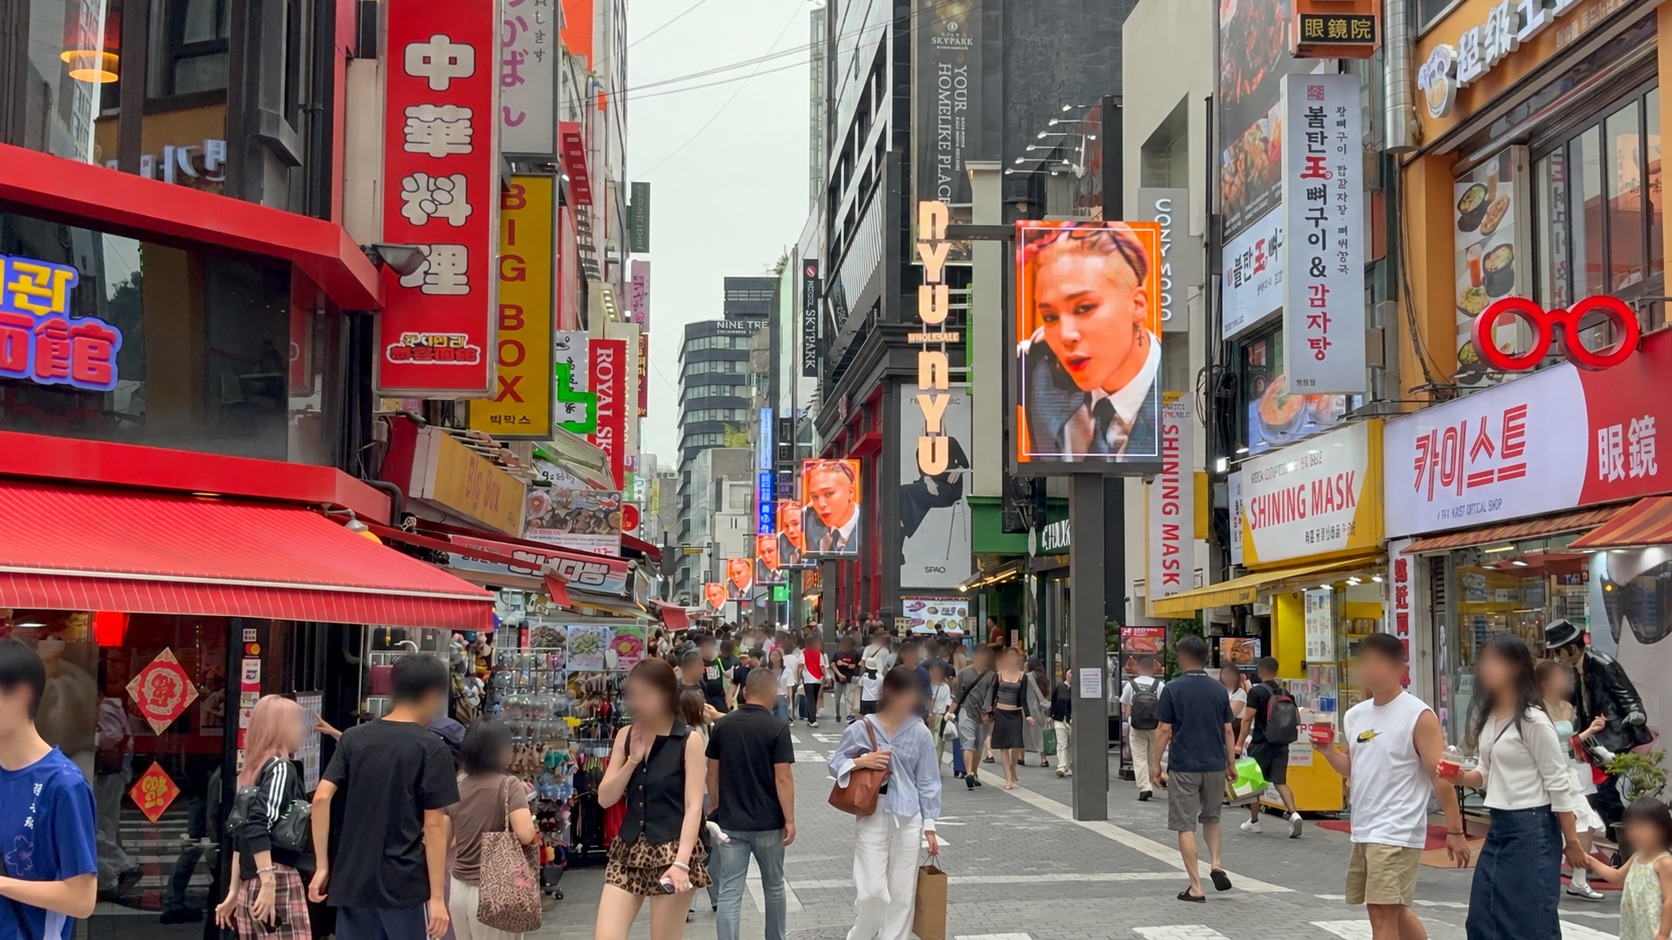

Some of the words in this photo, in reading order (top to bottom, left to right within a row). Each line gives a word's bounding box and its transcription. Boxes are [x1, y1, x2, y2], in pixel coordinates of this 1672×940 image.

[931, 36, 974, 46] SKYPARK
[1305, 18, 1371, 39] 眼鏡院
[937, 62, 952, 150] HOMELIKE
[954, 64, 968, 112] YOUR
[400, 34, 476, 295] 中華料理
[499, 184, 527, 283] BIG
[1307, 257, 1325, 278] &
[494, 304, 528, 402] BOX
[717, 321, 743, 329] NINE
[805, 309, 816, 368] SKYPARK
[1304, 284, 1330, 361] 감자탕
[597, 347, 614, 424] ROYAL
[1162, 424, 1179, 516] SHINING
[1413, 404, 1528, 502] 카이스트
[1598, 415, 1659, 482] 眼鏡
[1251, 484, 1306, 530] SHINING
[1312, 470, 1355, 516] MASK
[925, 565, 946, 575] SPAO
[1162, 523, 1180, 586] MASK
